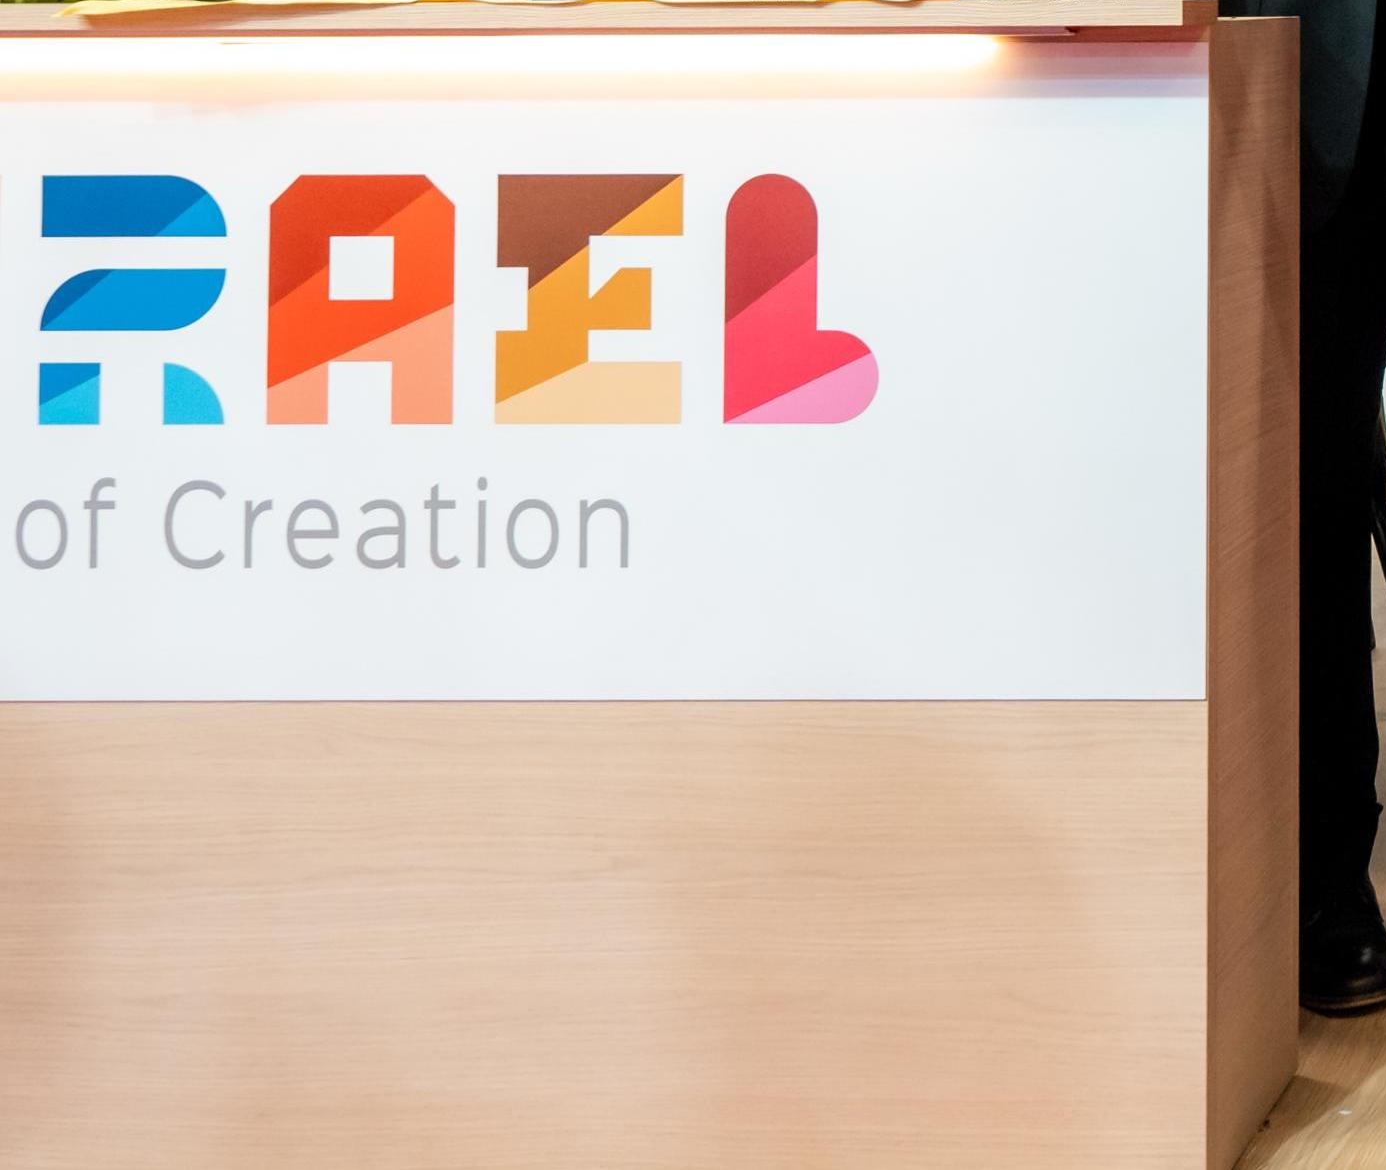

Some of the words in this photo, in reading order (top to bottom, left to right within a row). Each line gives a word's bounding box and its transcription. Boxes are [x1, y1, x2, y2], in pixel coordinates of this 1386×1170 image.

[39, 173, 880, 425] RAEL
[14, 477, 117, 571] of
[162, 477, 631, 571] Creation
